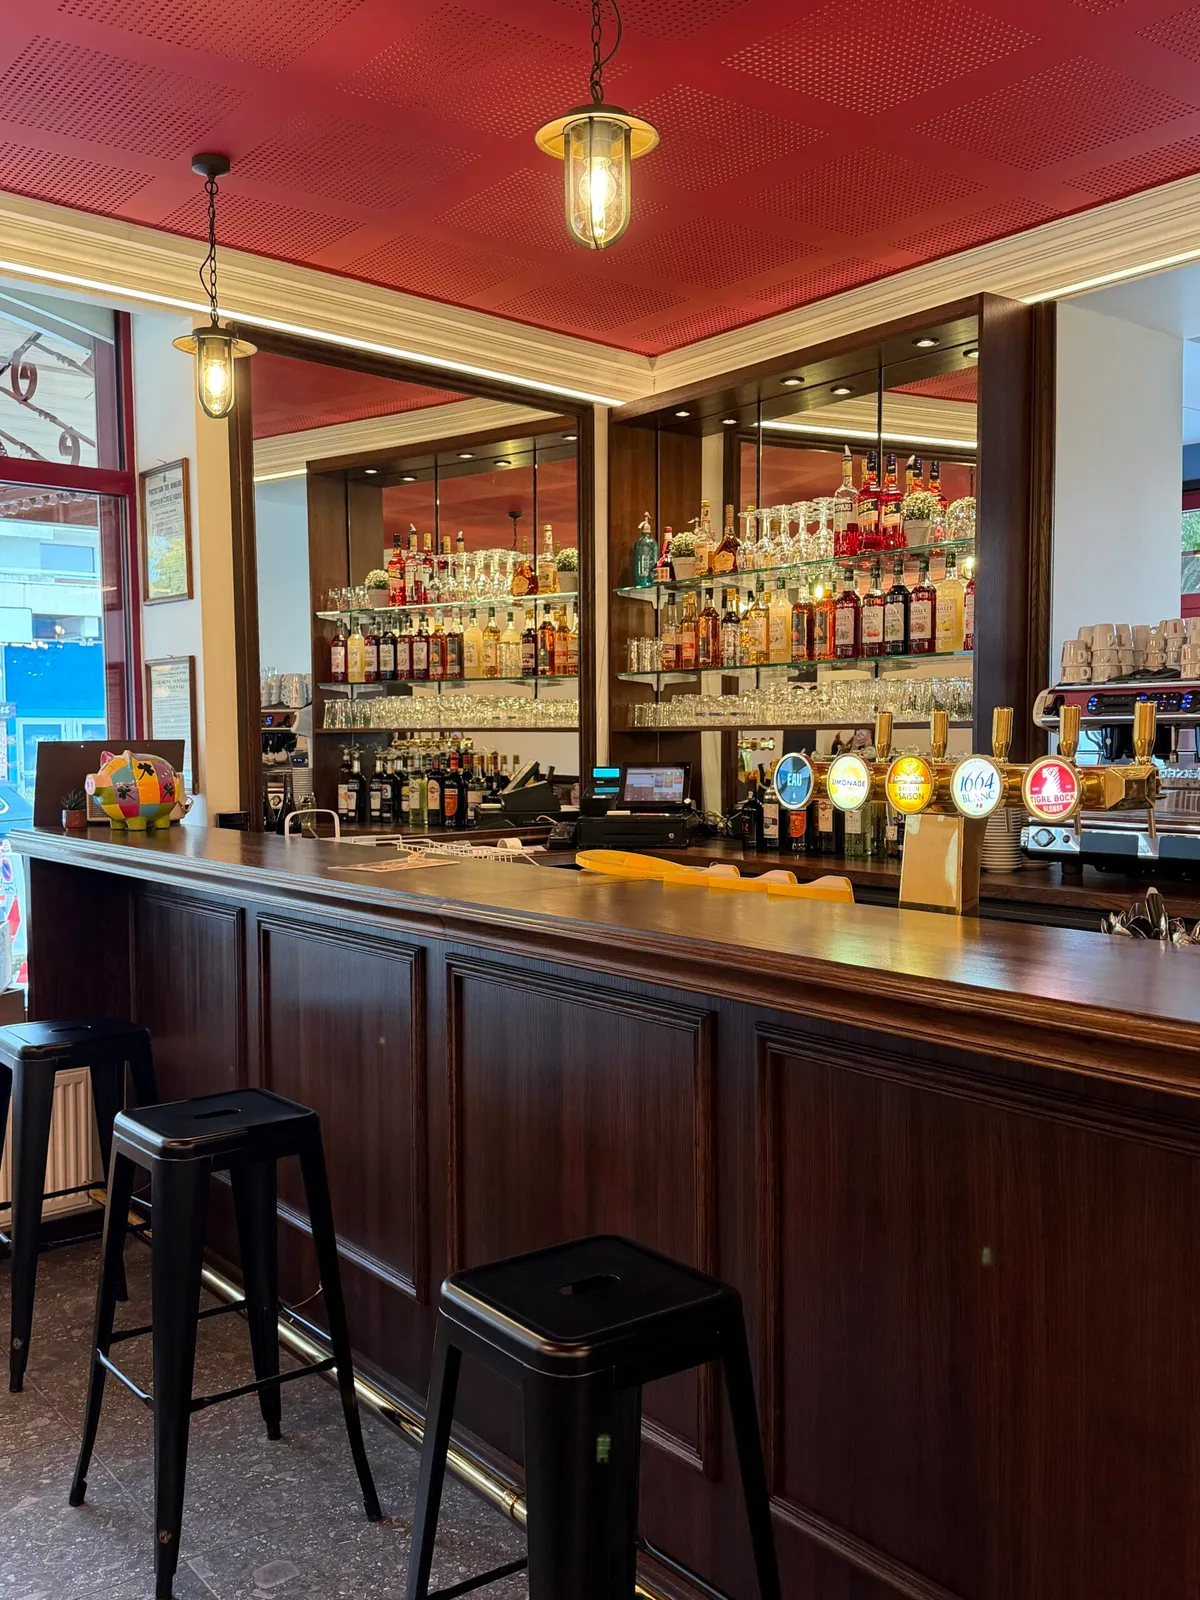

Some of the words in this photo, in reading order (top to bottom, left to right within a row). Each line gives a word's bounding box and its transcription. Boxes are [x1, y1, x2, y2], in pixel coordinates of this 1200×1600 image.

[787, 773, 803, 786] EAU
[832, 779, 866, 788] LIMONADE
[960, 771, 995, 792] 1664
[898, 792, 924, 801] SAISON
[962, 790, 996, 803] BLANC
[1030, 795, 1052, 804] TIGRE
[1054, 793, 1076, 802] BOCK
